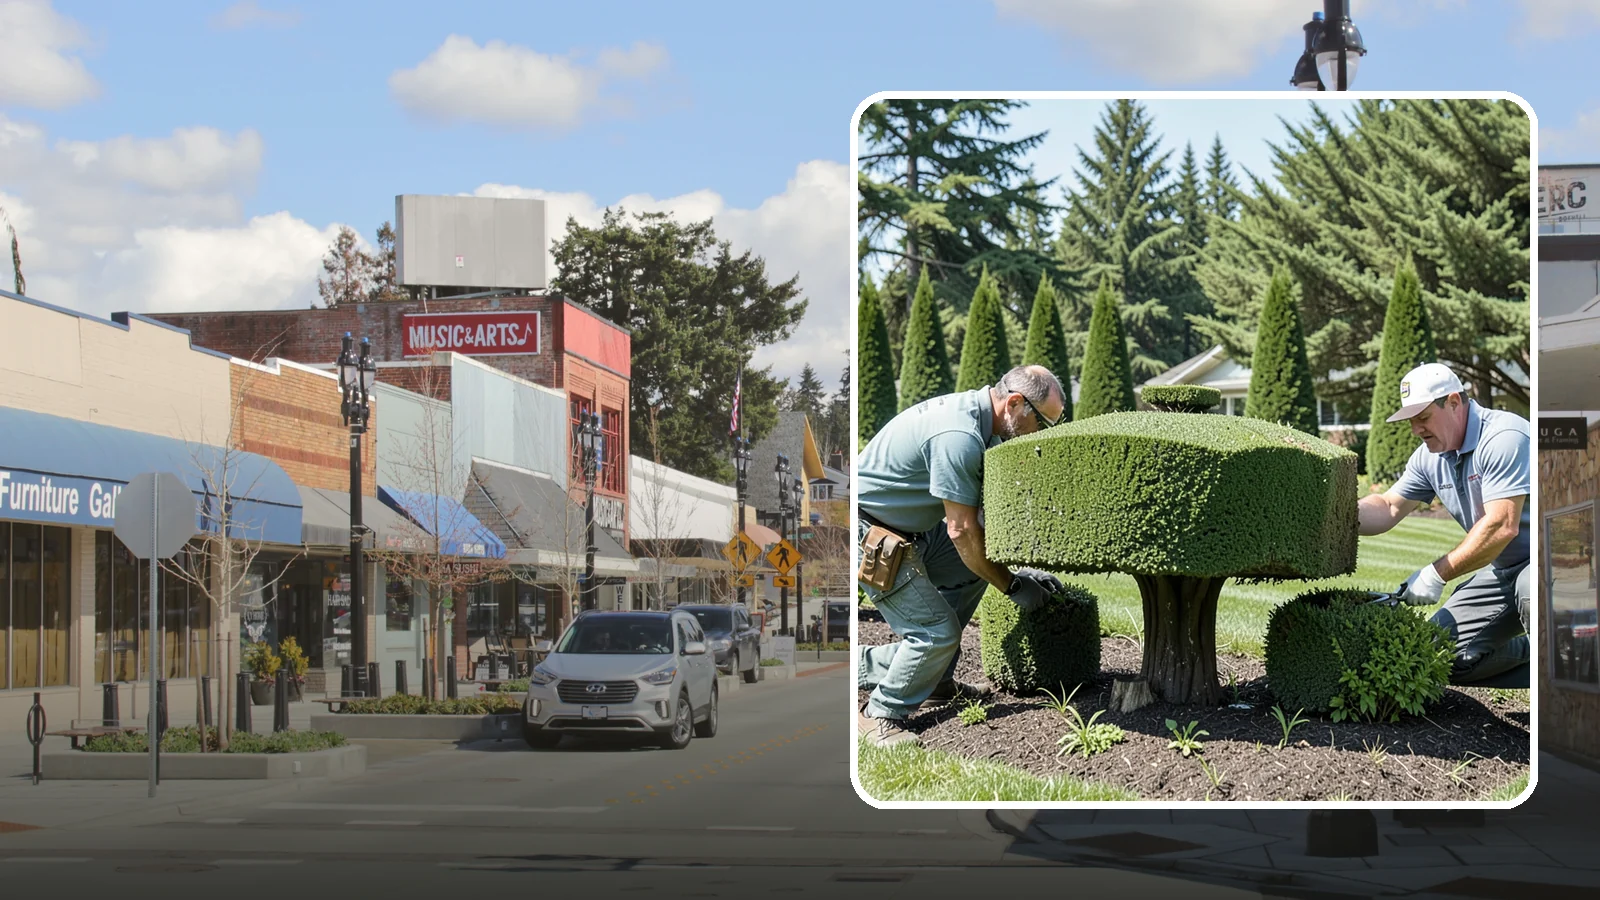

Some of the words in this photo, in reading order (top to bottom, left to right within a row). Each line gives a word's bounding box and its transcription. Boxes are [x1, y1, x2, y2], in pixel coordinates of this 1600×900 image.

[409, 323, 520, 348] MUSIC&ARTS
[0, 471, 79, 515] Furniture
[454, 563, 480, 574] SUSHI
